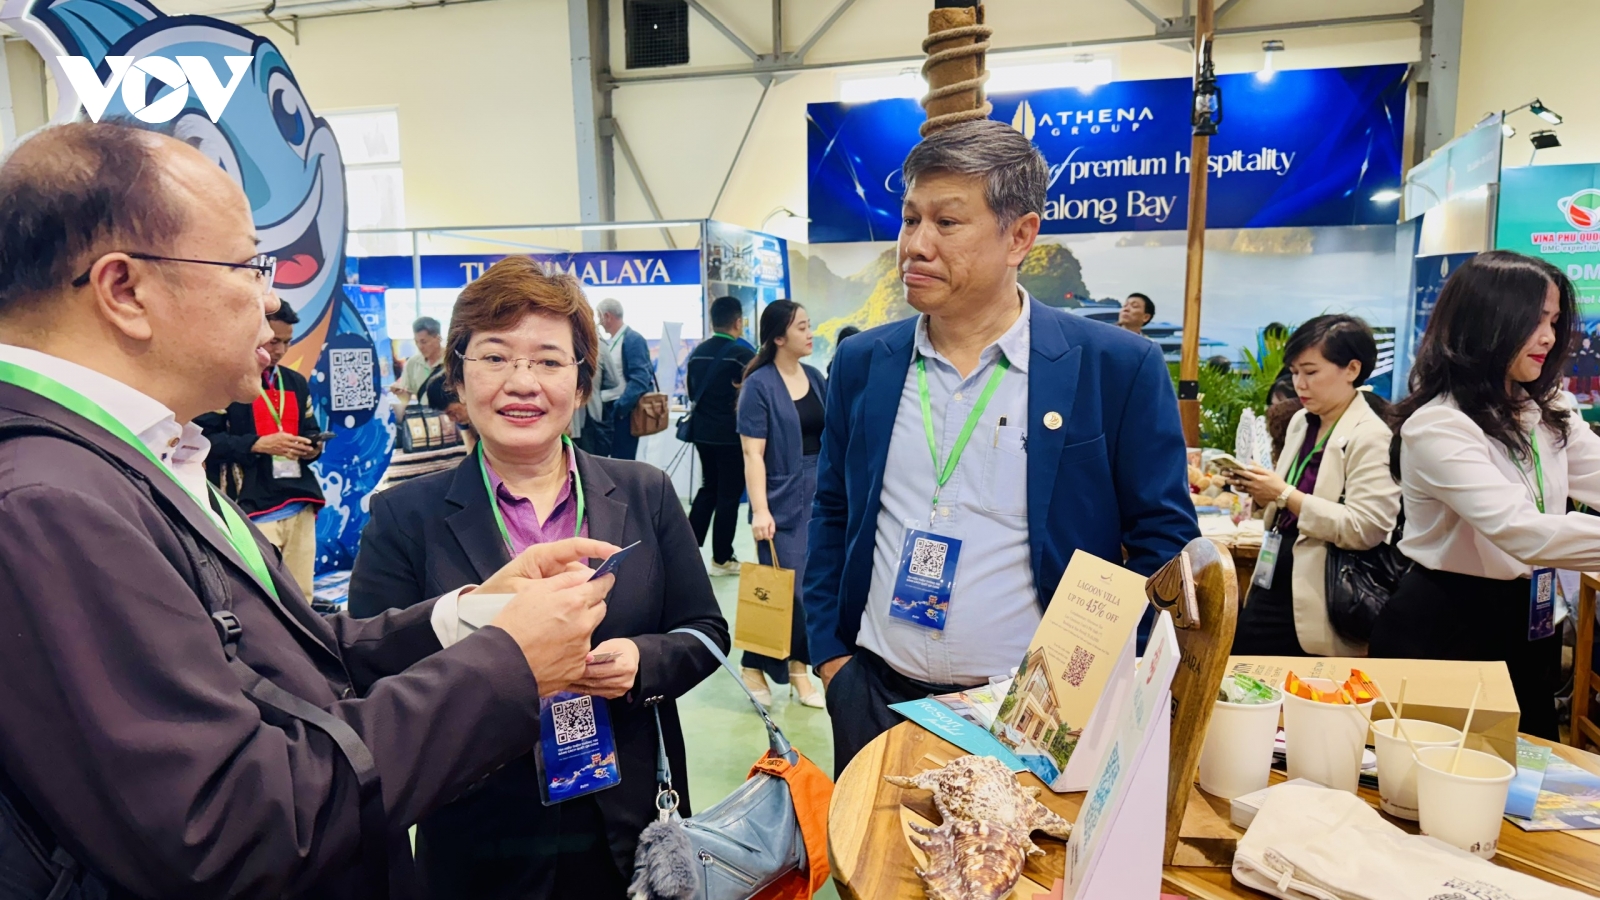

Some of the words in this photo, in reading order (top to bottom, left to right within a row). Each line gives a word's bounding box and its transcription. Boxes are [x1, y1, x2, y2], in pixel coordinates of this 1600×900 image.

[1038, 107, 1154, 127] ATHENA
[1051, 122, 1141, 137] GROUP
[1070, 155, 1167, 185] premium
[1174, 147, 1296, 178] hspitality
[1043, 194, 1118, 225] along
[1127, 190, 1177, 223] Bay
[1533, 234, 1555, 243] VINA
[1558, 233, 1576, 242] PHU
[1580, 232, 1600, 242] QUO
[537, 259, 671, 285] IMALAYA
[1077, 580, 1104, 598] LAGOON
[1103, 591, 1121, 606] VILLA
[1067, 592, 1077, 602] UP
[1076, 596, 1086, 607] TO
[1085, 598, 1107, 618] 45%
[1105, 611, 1120, 624] OFF
